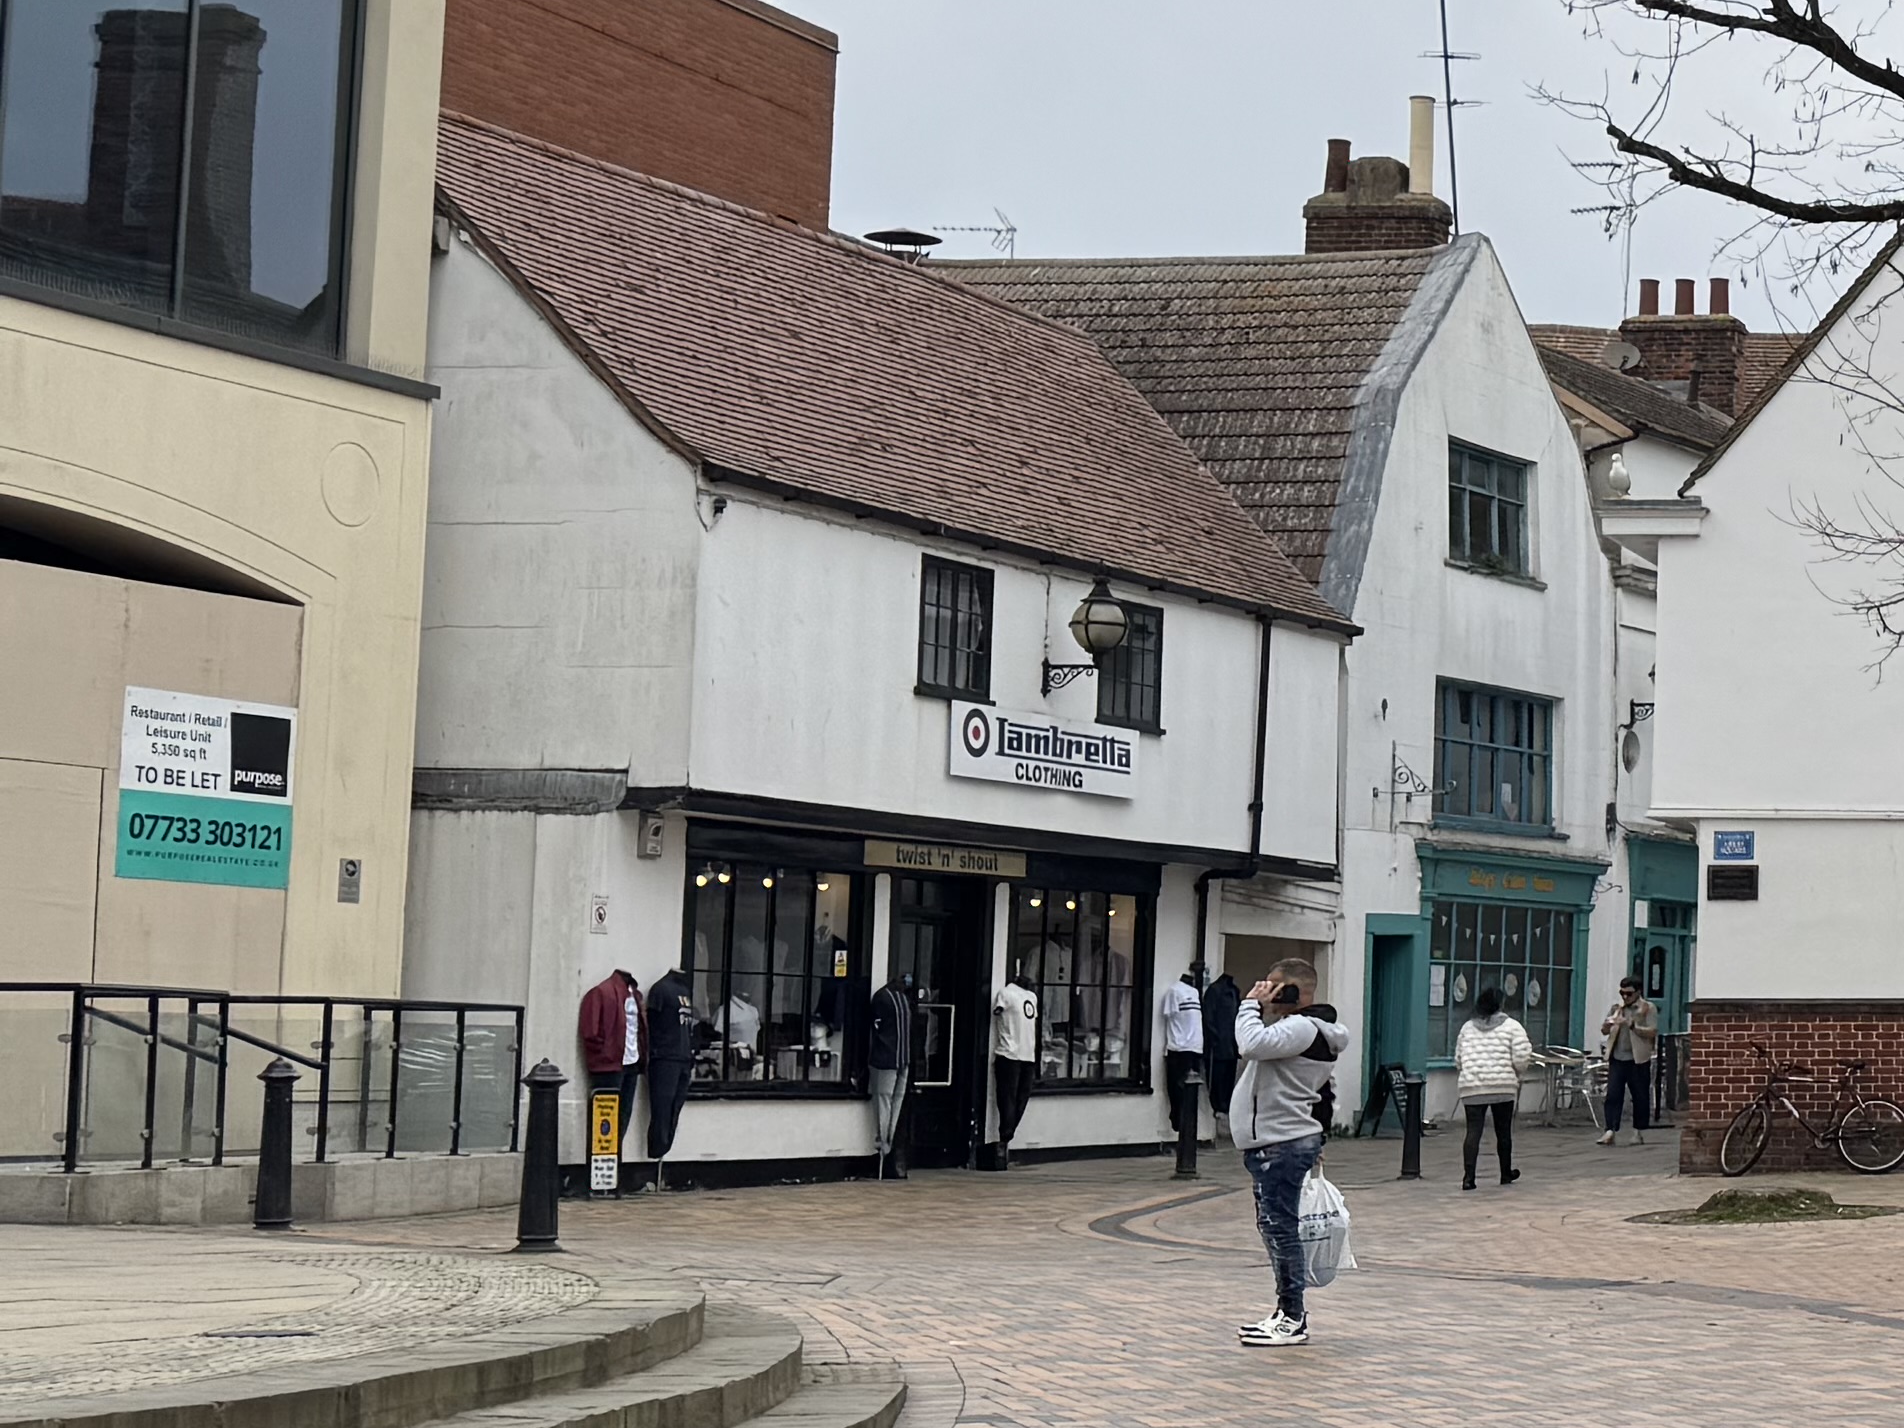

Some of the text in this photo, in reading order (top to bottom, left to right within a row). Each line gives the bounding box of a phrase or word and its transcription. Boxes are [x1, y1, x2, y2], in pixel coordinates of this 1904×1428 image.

[130, 705, 186, 724] Restaurant
[194, 713, 222, 728] Retail
[146, 724, 212, 743] Leisure Unit
[995, 717, 1131, 774] Lambretta
[151, 742, 207, 762] 5,350 sq ft
[135, 765, 222, 790] TO BE LET
[1015, 762, 1083, 788] CLOTHING
[129, 812, 282, 851] 07733 303121
[896, 845, 932, 866] twist
[959, 853, 998, 872] shout
